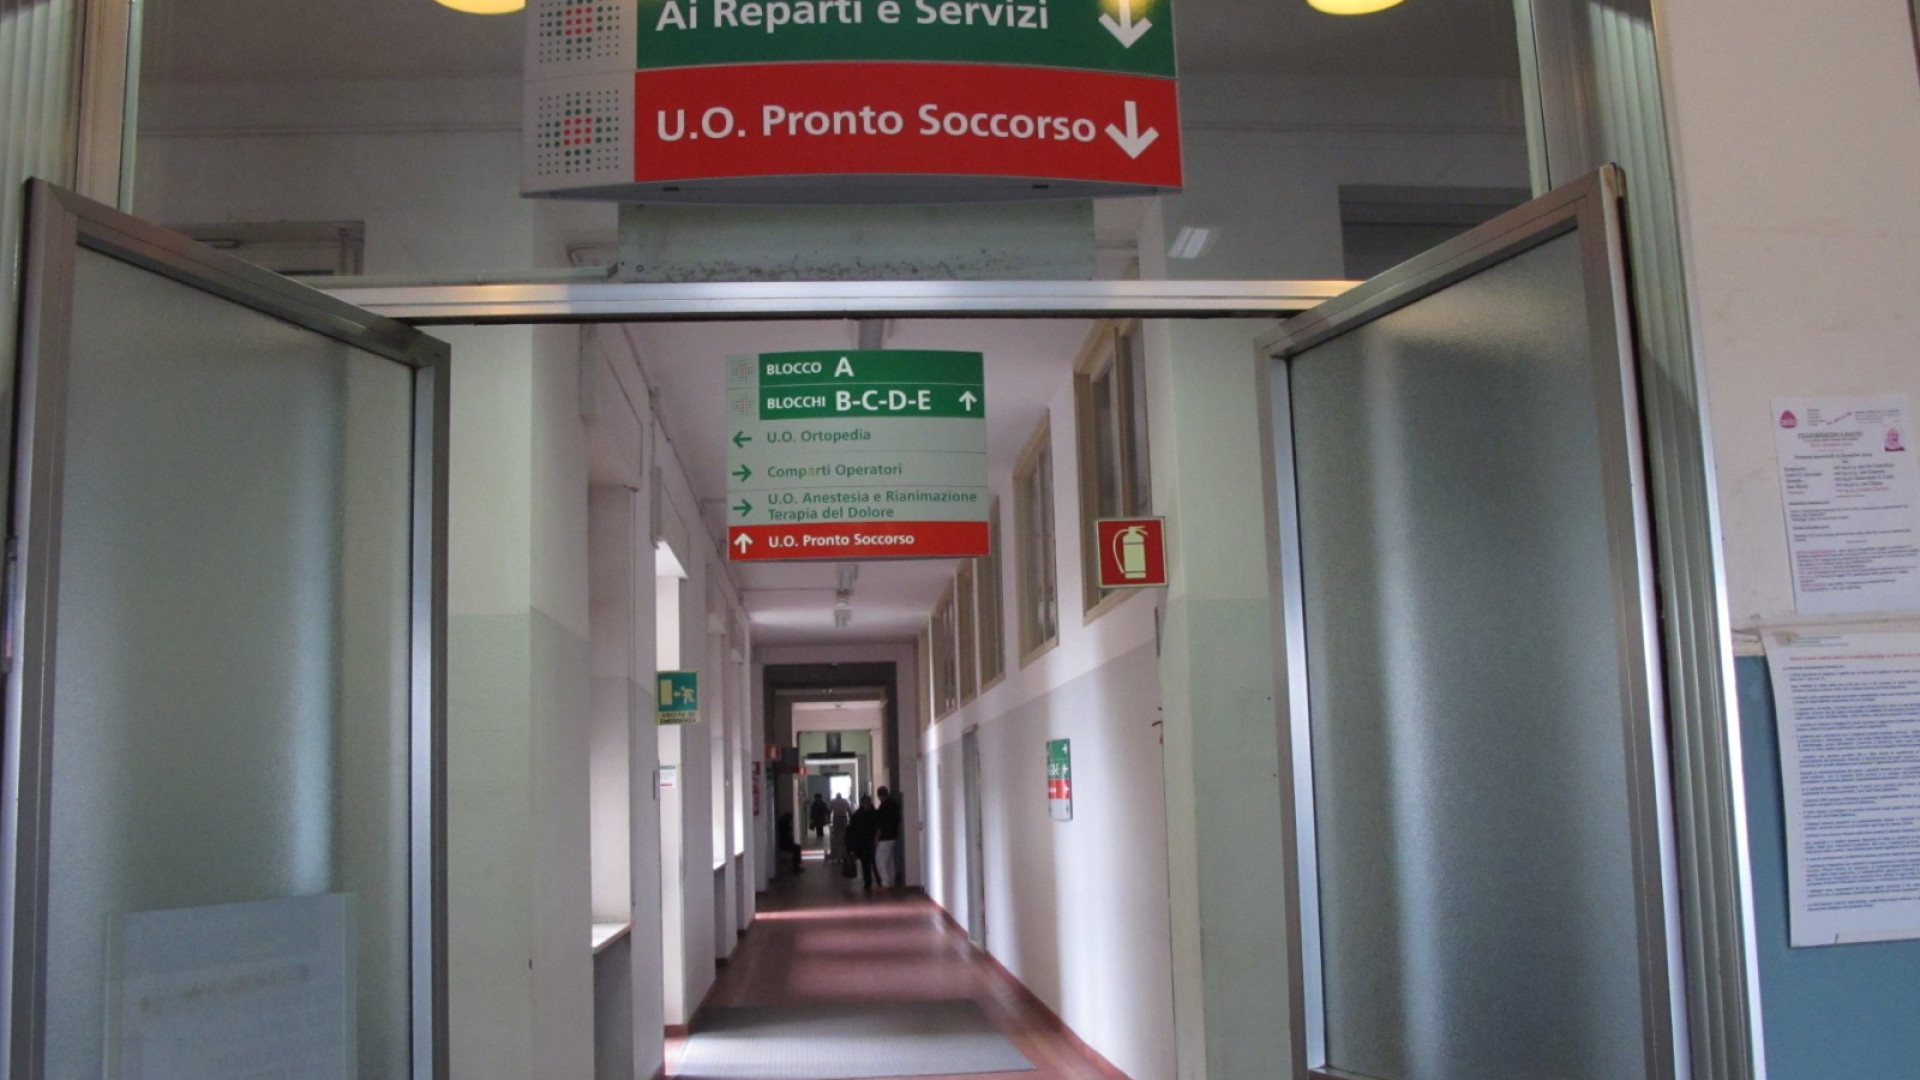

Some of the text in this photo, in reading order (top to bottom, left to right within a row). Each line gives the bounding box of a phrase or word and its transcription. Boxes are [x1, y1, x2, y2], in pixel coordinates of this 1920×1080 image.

[655, 0, 1048, 34] Ai Reparti e Servizi
[656, 103, 1096, 143] U.O. Pronto Soccorso
[766, 357, 854, 377] BLOCCO A
[767, 390, 931, 411] BLOCCHI B-C-D-E
[767, 429, 871, 444] U.O. Ortopedia
[768, 464, 902, 479] Comparti Operatori
[768, 490, 977, 504] U.O. Anestesia e Rianimazione
[768, 507, 894, 522] Terapia del Dolore
[768, 534, 915, 548] U.O. Pronto Soccorso
